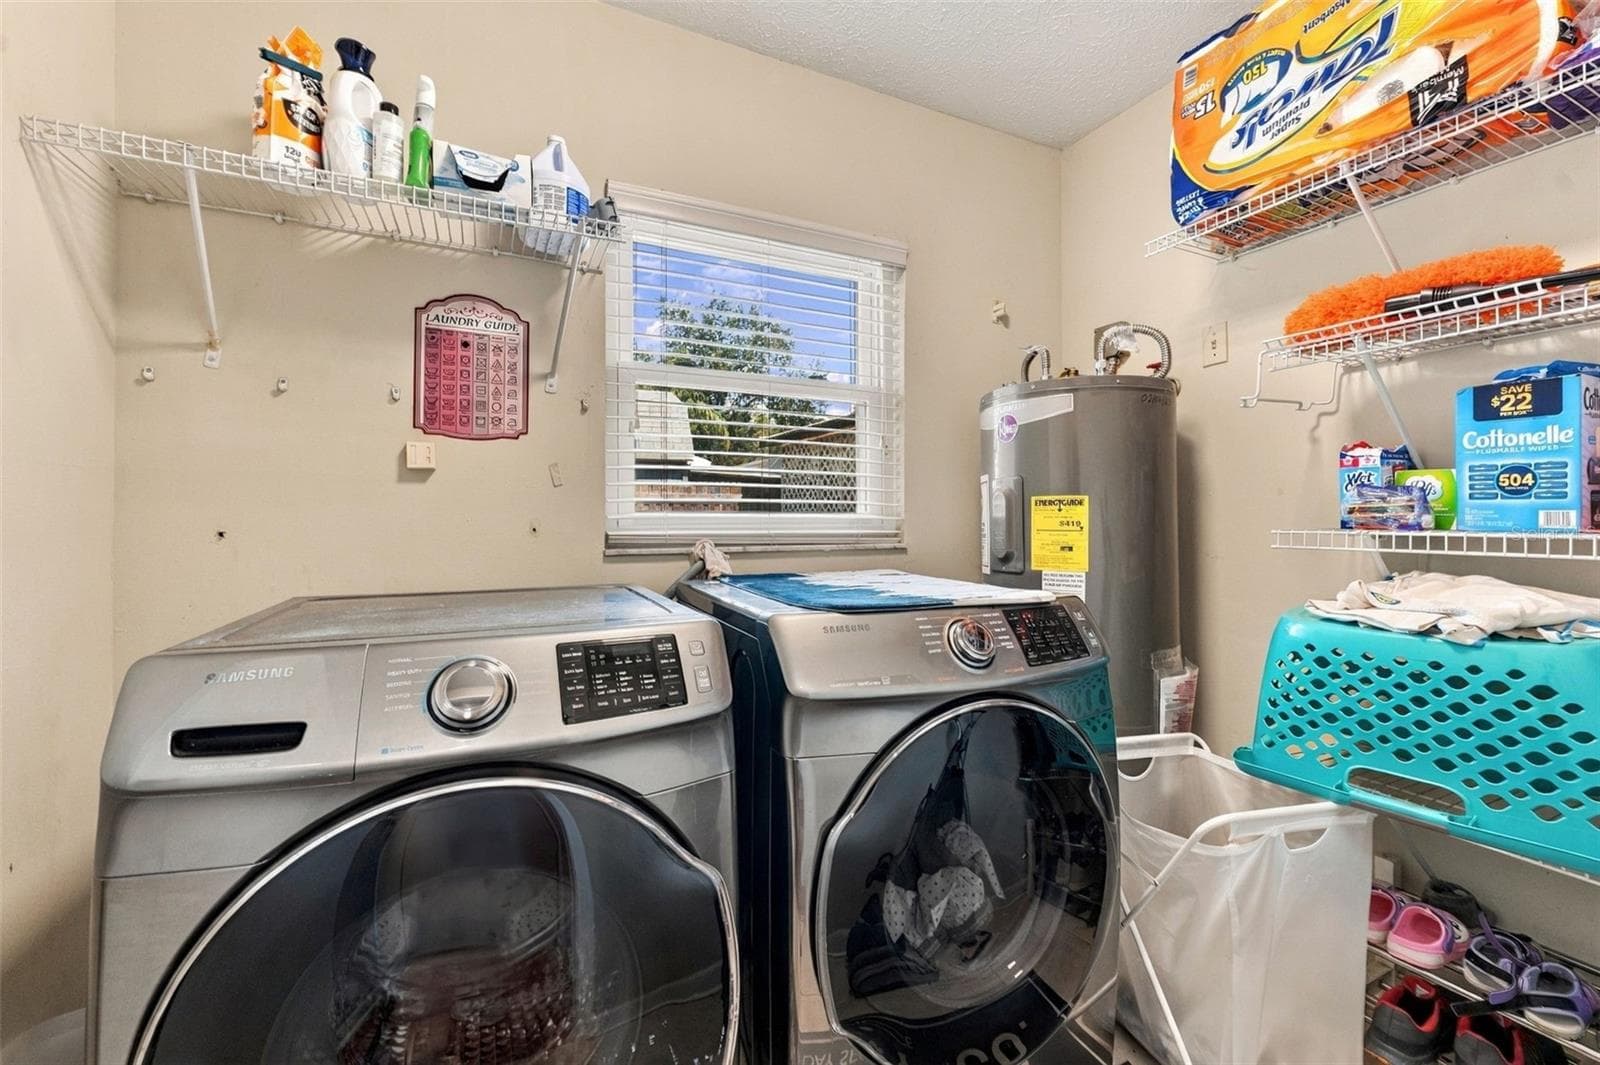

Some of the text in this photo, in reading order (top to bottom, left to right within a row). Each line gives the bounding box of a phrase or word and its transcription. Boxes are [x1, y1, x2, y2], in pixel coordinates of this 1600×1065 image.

[1241, 63, 1270, 86] 150
[1193, 89, 1217, 120] 15
[1262, 97, 1311, 137] Premium
[1270, 113, 1302, 140] Super
[425, 313, 520, 333] LAUNDRY GUIDE
[1500, 383, 1532, 395] SAVE
[1490, 392, 1532, 412] $22
[1462, 424, 1575, 450] Cottonelle
[1498, 472, 1535, 487] 504
[822, 623, 871, 634] SAMSUNG
[204, 666, 295, 685] SAMSUNG
